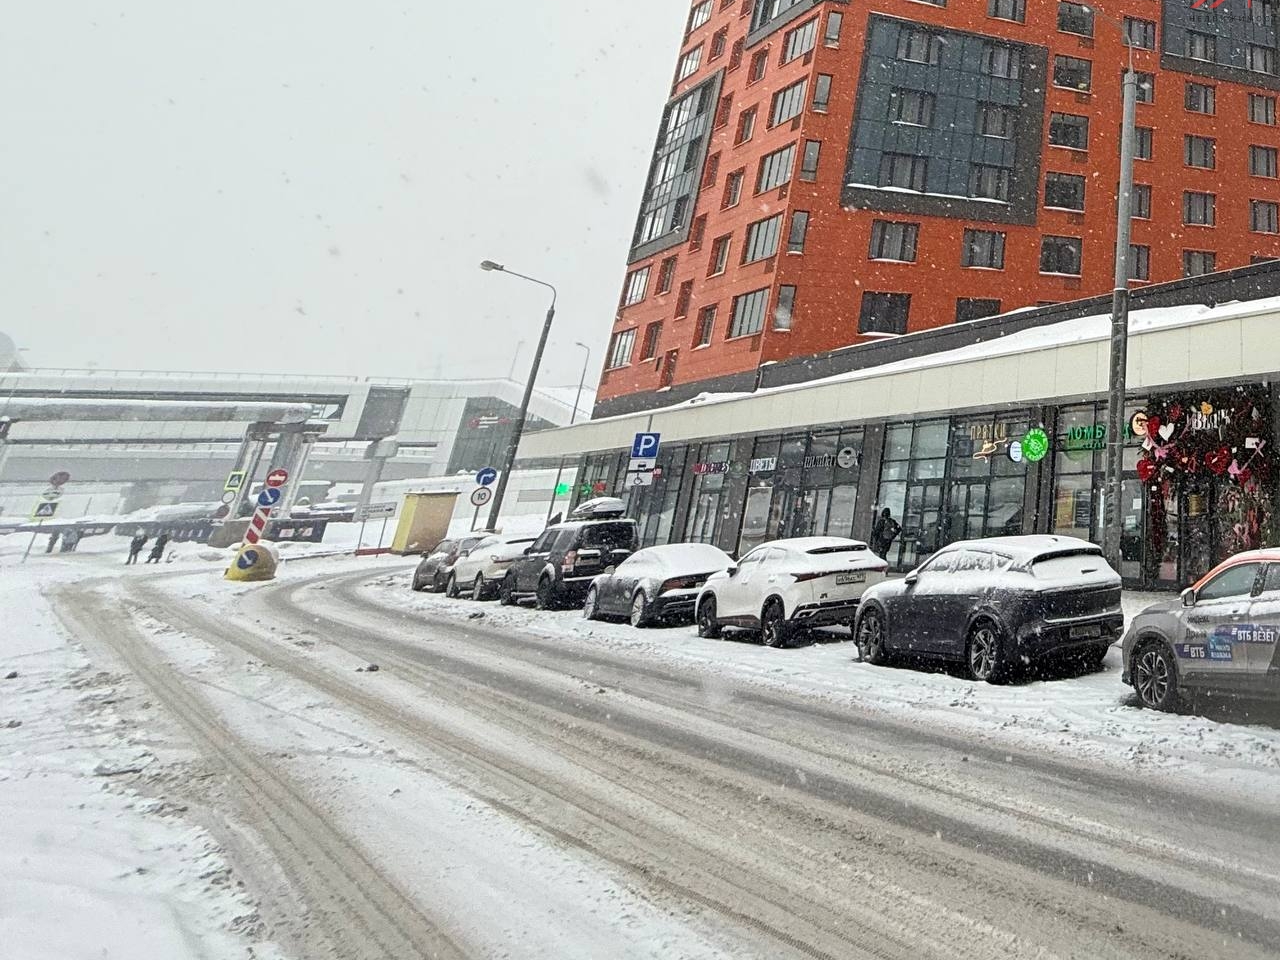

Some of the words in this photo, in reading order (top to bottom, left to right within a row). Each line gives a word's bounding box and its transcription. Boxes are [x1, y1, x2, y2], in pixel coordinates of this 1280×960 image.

[638, 435, 656, 456] P
[476, 491, 486, 501] 10
[1237, 630, 1252, 641] ВТБ
[1190, 646, 1205, 658] ВТБ
